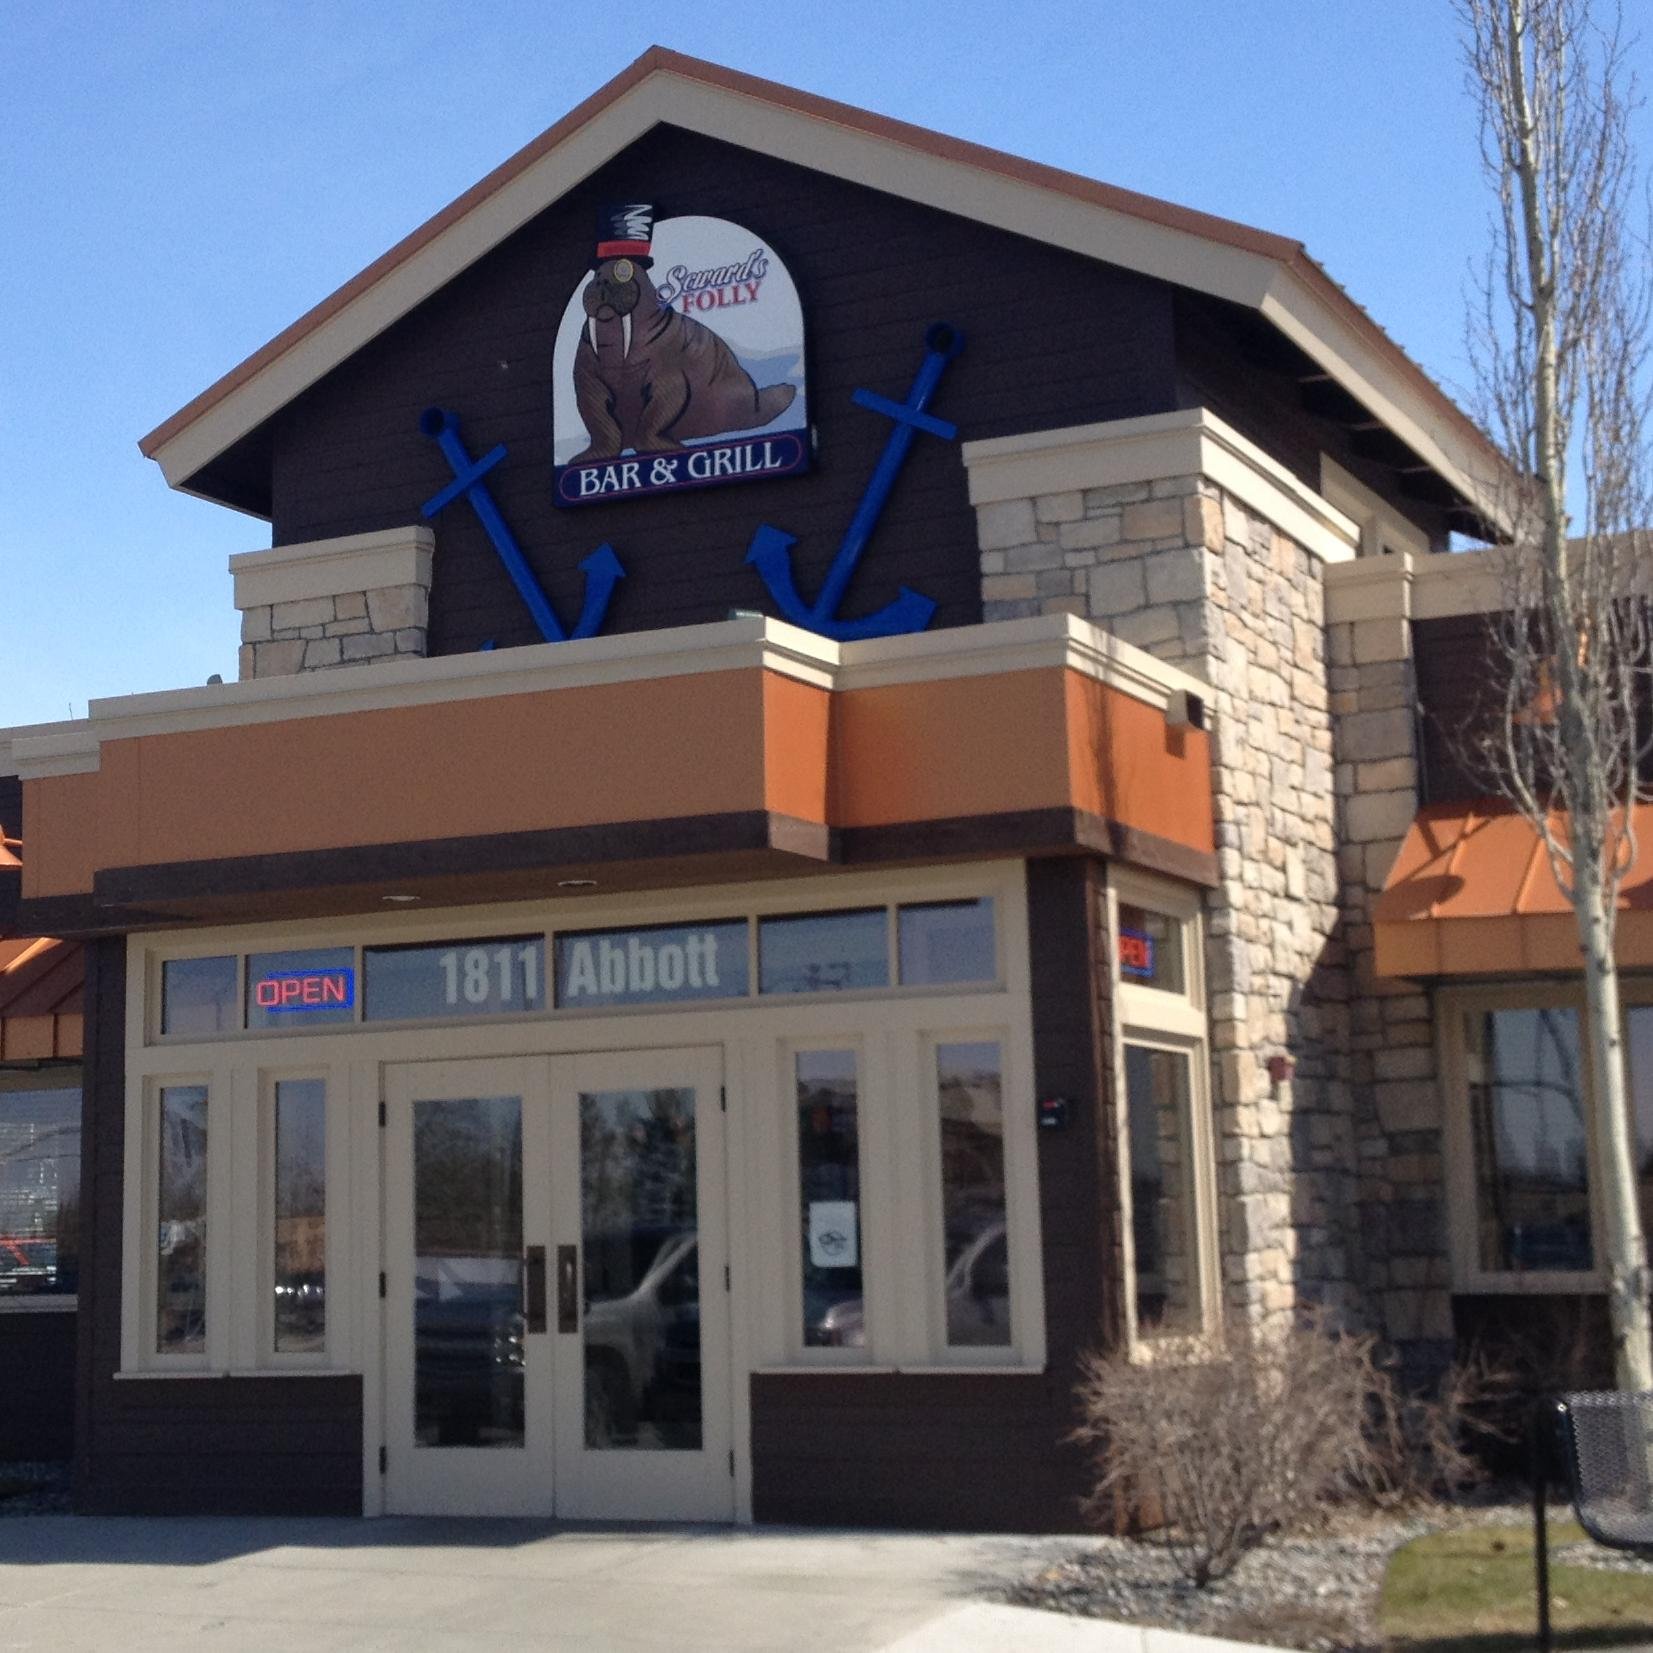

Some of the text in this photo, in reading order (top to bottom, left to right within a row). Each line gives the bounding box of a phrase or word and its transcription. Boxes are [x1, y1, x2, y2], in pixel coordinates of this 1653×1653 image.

[656, 248, 769, 305] Seward's
[681, 281, 760, 314] FOLLY
[580, 442, 781, 496] BAR & GRILL
[256, 975, 345, 1006] OPEN
[439, 934, 719, 1004] 1811 Abbott
